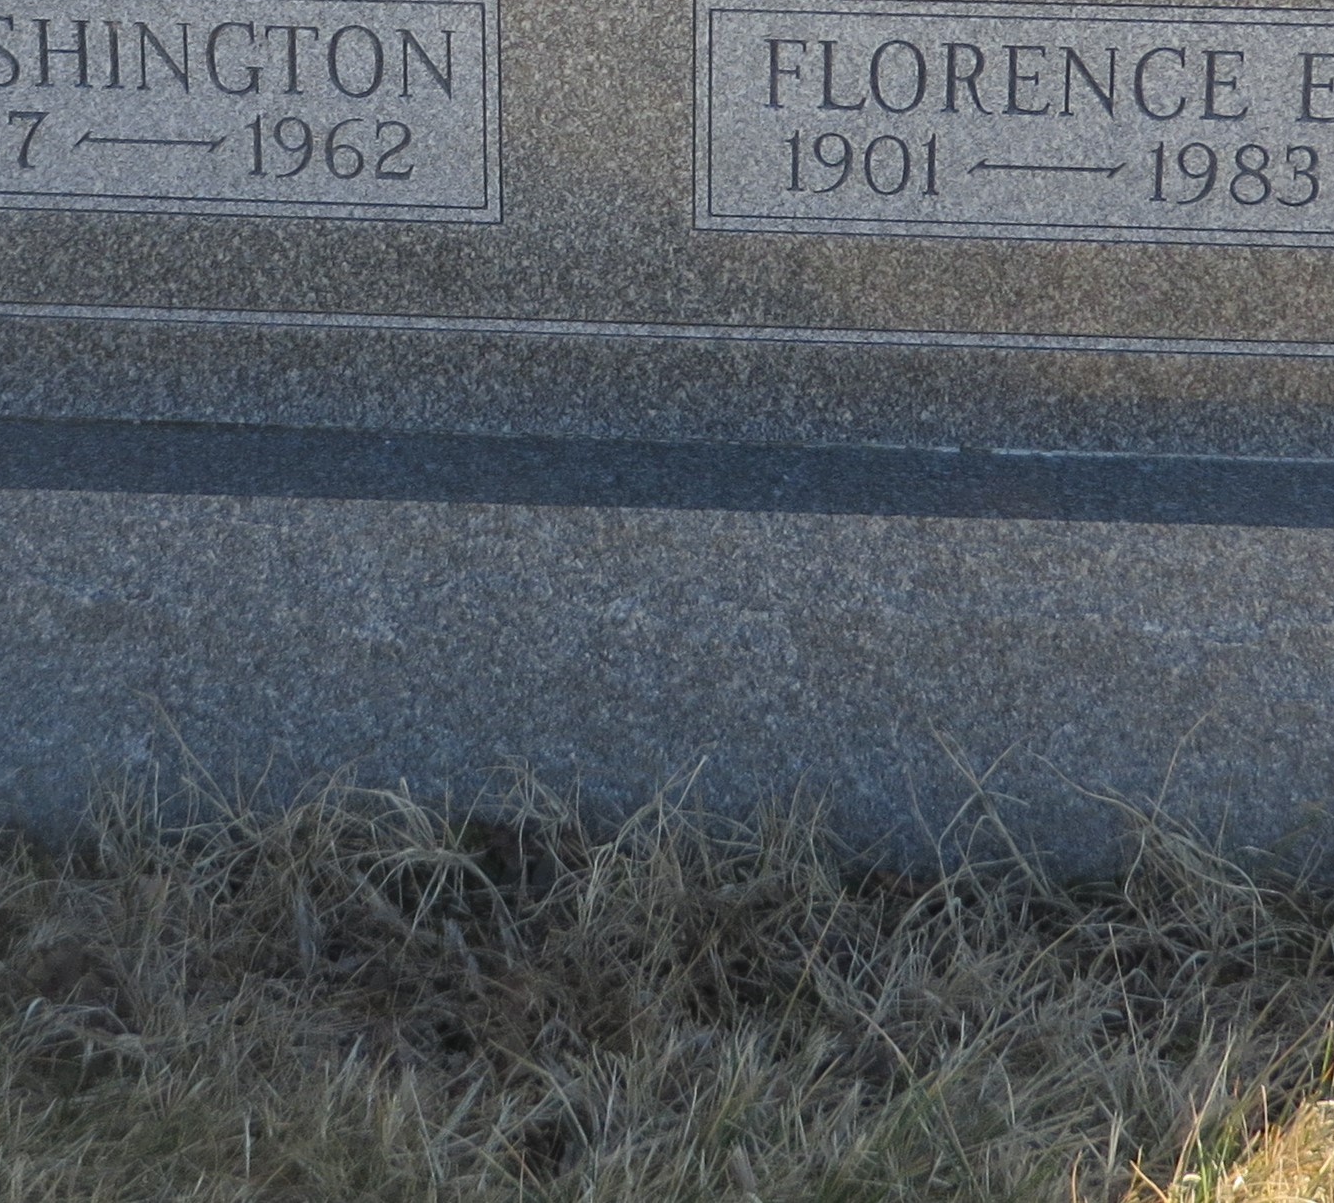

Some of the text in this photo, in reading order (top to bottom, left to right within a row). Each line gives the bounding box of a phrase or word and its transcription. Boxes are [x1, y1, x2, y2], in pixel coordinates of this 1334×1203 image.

[764, 37, 1249, 121] FLORENCE
[245, 113, 415, 182] 1962
[784, 128, 1322, 208] 1901 1983
